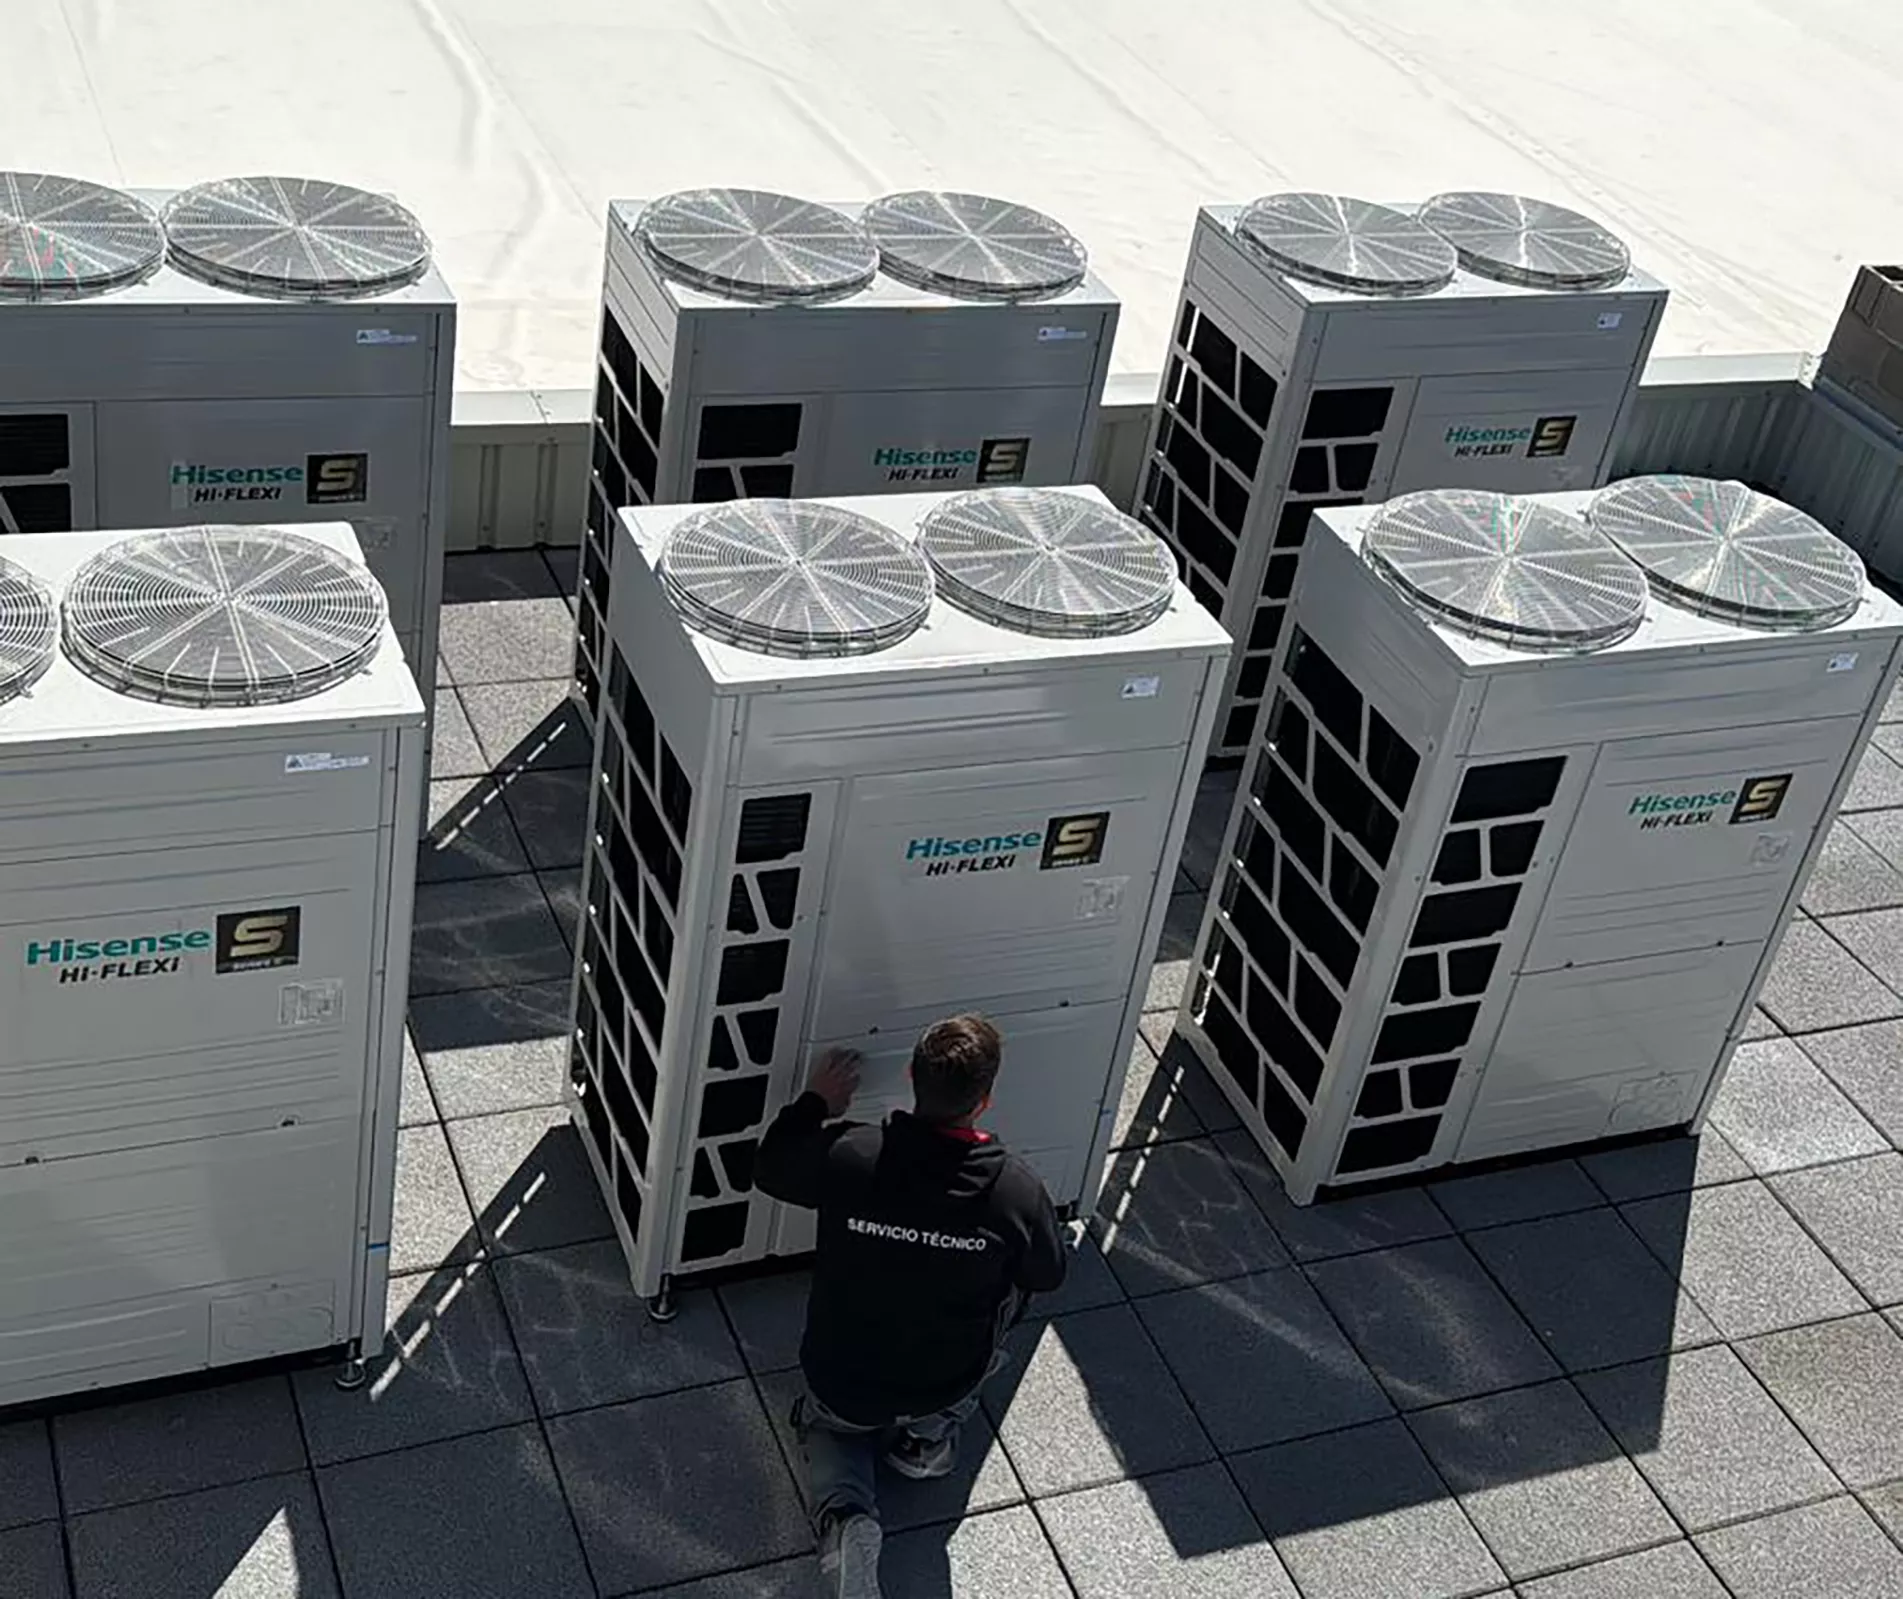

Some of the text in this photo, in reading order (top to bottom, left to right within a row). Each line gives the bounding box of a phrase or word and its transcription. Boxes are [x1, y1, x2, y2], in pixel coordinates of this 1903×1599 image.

[1444, 427, 1531, 443] Hisense
[874, 448, 977, 466] Hisense
[171, 465, 304, 484] Hisense
[316, 458, 358, 491] S
[1629, 790, 1737, 815] Hisense
[1740, 779, 1787, 811] S
[906, 831, 1042, 859] Hisense
[1052, 819, 1100, 855] S
[27, 930, 211, 966] Hisense
[229, 914, 289, 958] S
[847, 1217, 987, 1251] SERVICIO TÉCNICO
